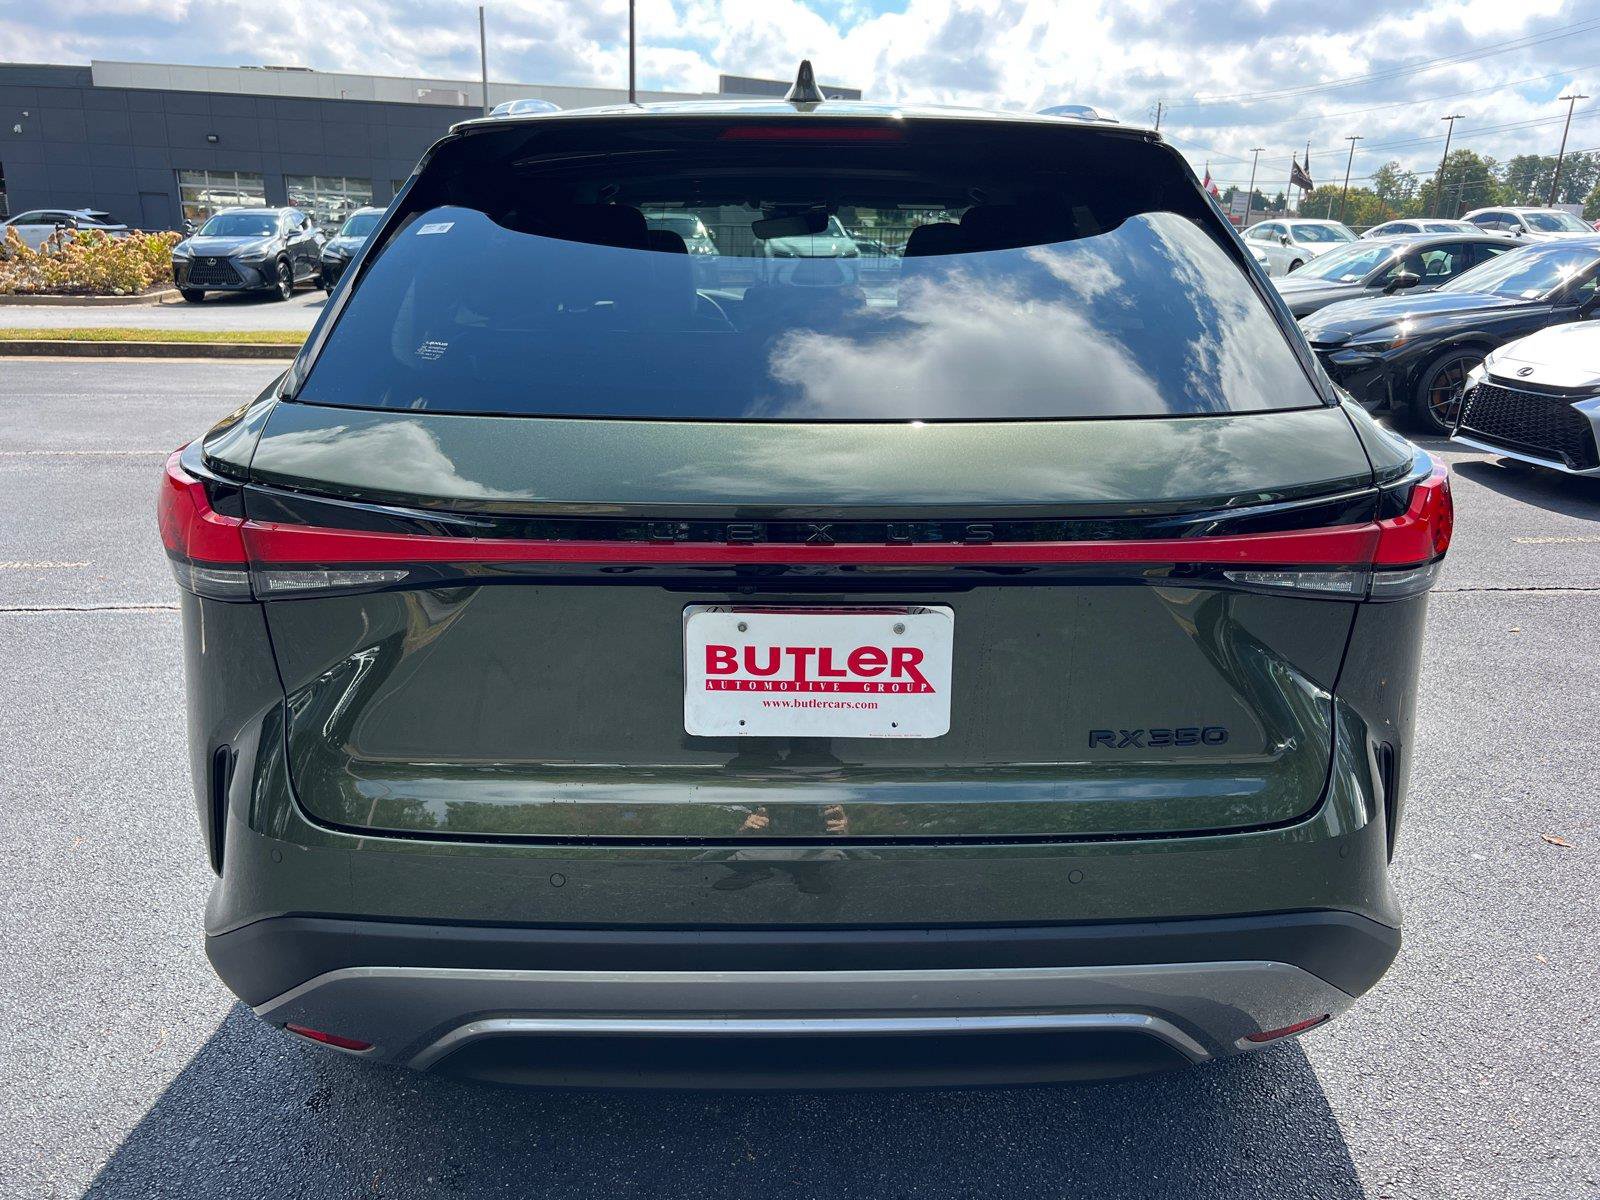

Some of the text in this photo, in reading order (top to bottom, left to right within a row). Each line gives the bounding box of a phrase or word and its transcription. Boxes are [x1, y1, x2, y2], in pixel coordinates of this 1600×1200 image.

[648, 522, 993, 542] LEXUS
[706, 681, 928, 692] AUTOMOTIVE GROUP
[762, 699, 879, 710] www.butlercars.com
